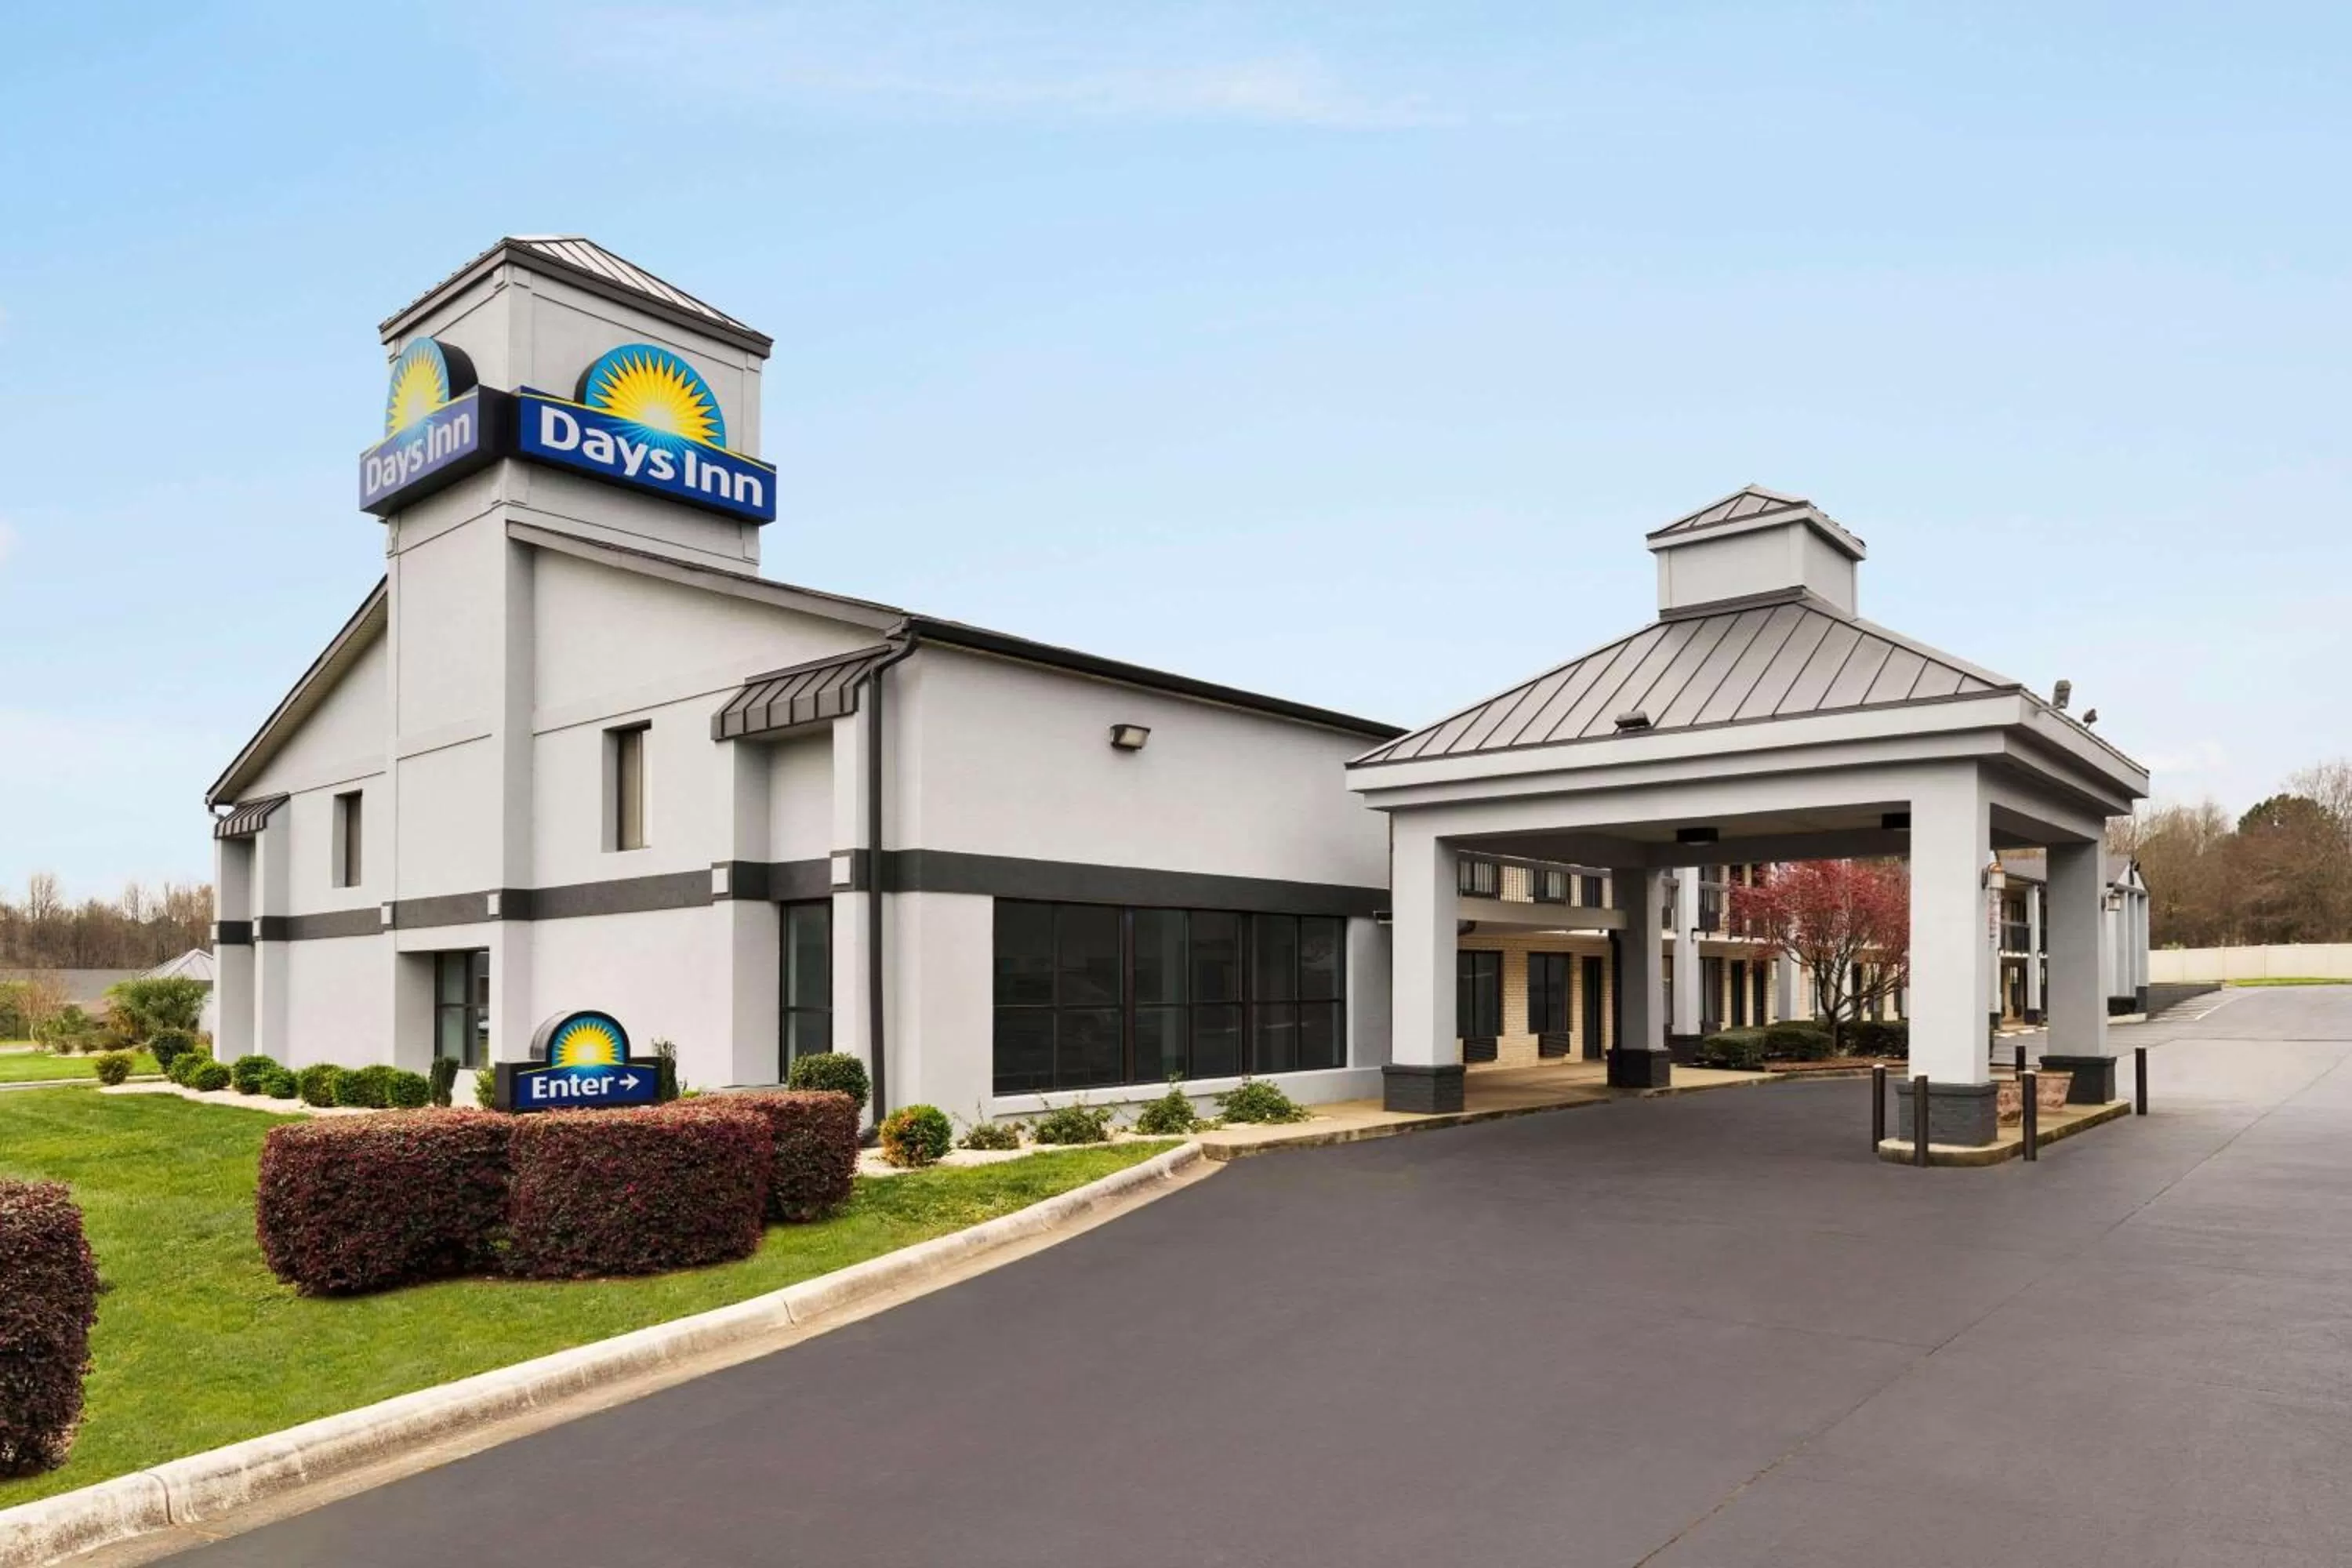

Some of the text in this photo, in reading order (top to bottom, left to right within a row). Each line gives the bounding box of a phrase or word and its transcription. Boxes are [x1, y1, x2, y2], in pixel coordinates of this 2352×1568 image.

[365, 412, 470, 497] Days Inn
[540, 405, 764, 508] Days Inn
[532, 1073, 615, 1099] Enter
